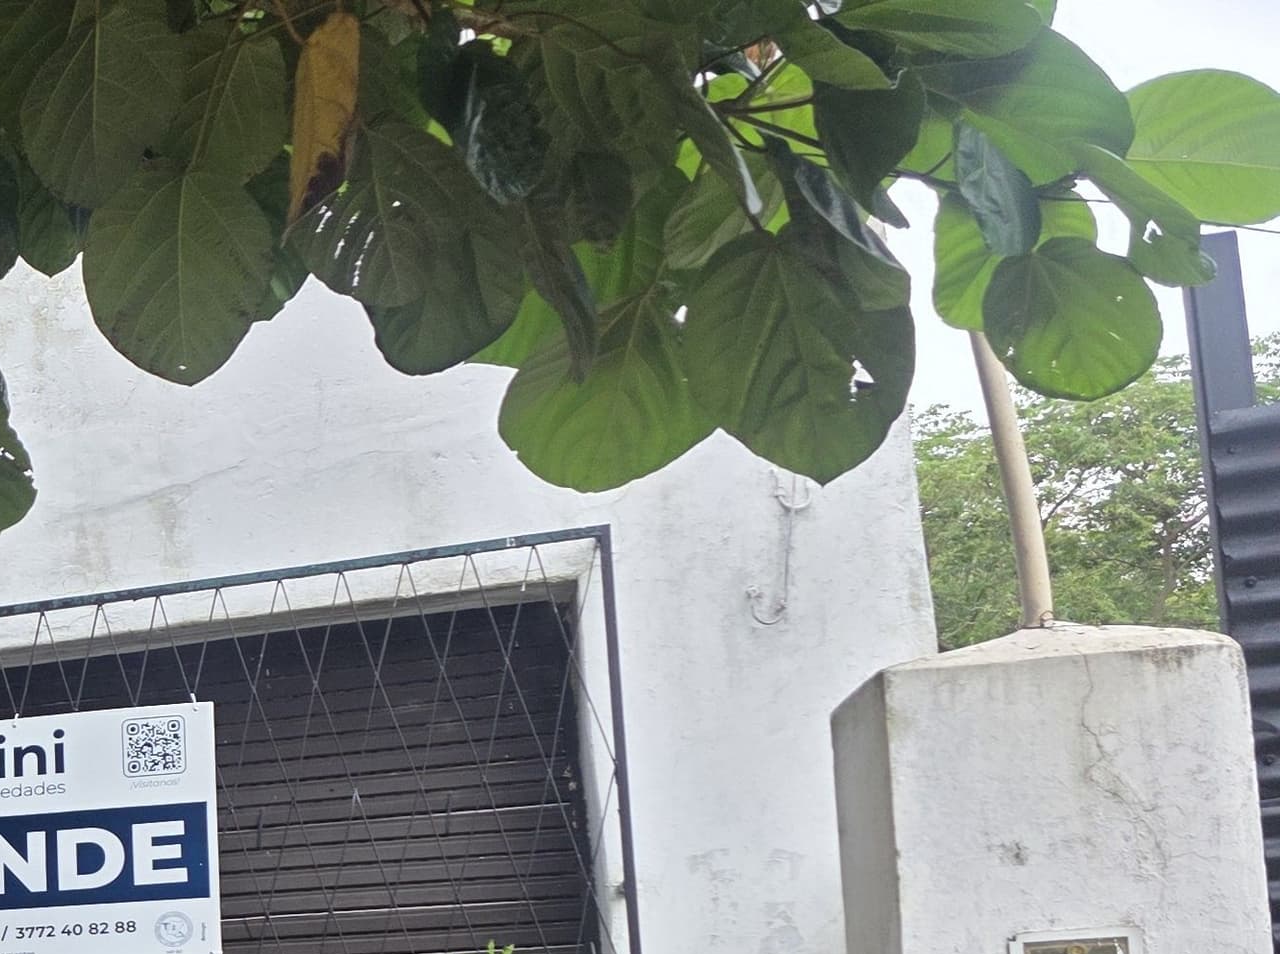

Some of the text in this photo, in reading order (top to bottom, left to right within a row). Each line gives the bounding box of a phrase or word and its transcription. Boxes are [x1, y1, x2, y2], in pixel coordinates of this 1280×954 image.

[1, 925, 9, 941] /
[15, 925, 56, 939] 3772
[61, 923, 83, 936] 40
[89, 922, 109, 935] 82
[114, 920, 137, 933] 88
